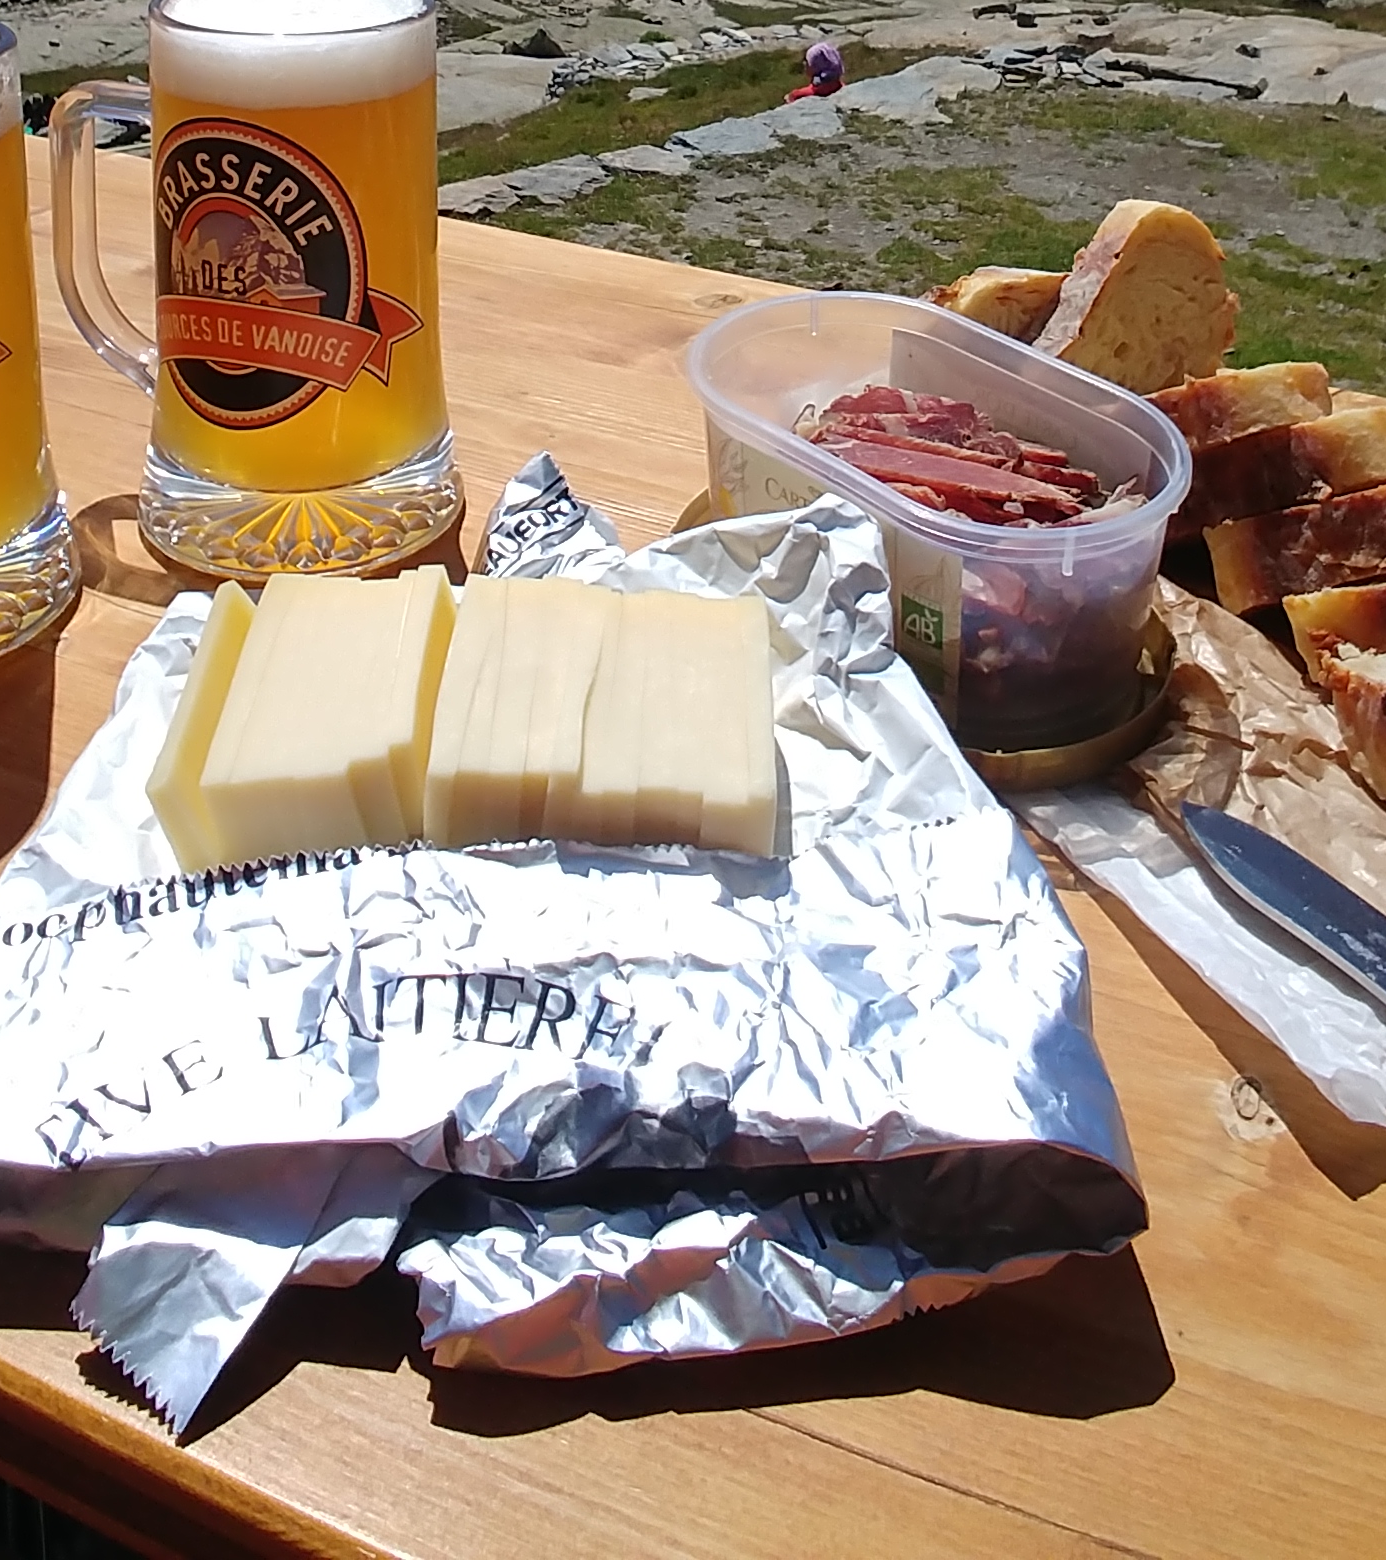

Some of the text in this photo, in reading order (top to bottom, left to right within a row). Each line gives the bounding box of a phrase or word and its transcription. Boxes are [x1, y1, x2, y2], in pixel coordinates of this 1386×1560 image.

[157, 152, 333, 248] BRASSERIE
[201, 259, 247, 296] DES
[217, 317, 245, 347] DE
[252, 324, 353, 367] VANOISE
[765, 477, 810, 508] CART
[484, 486, 578, 574] AUFORT
